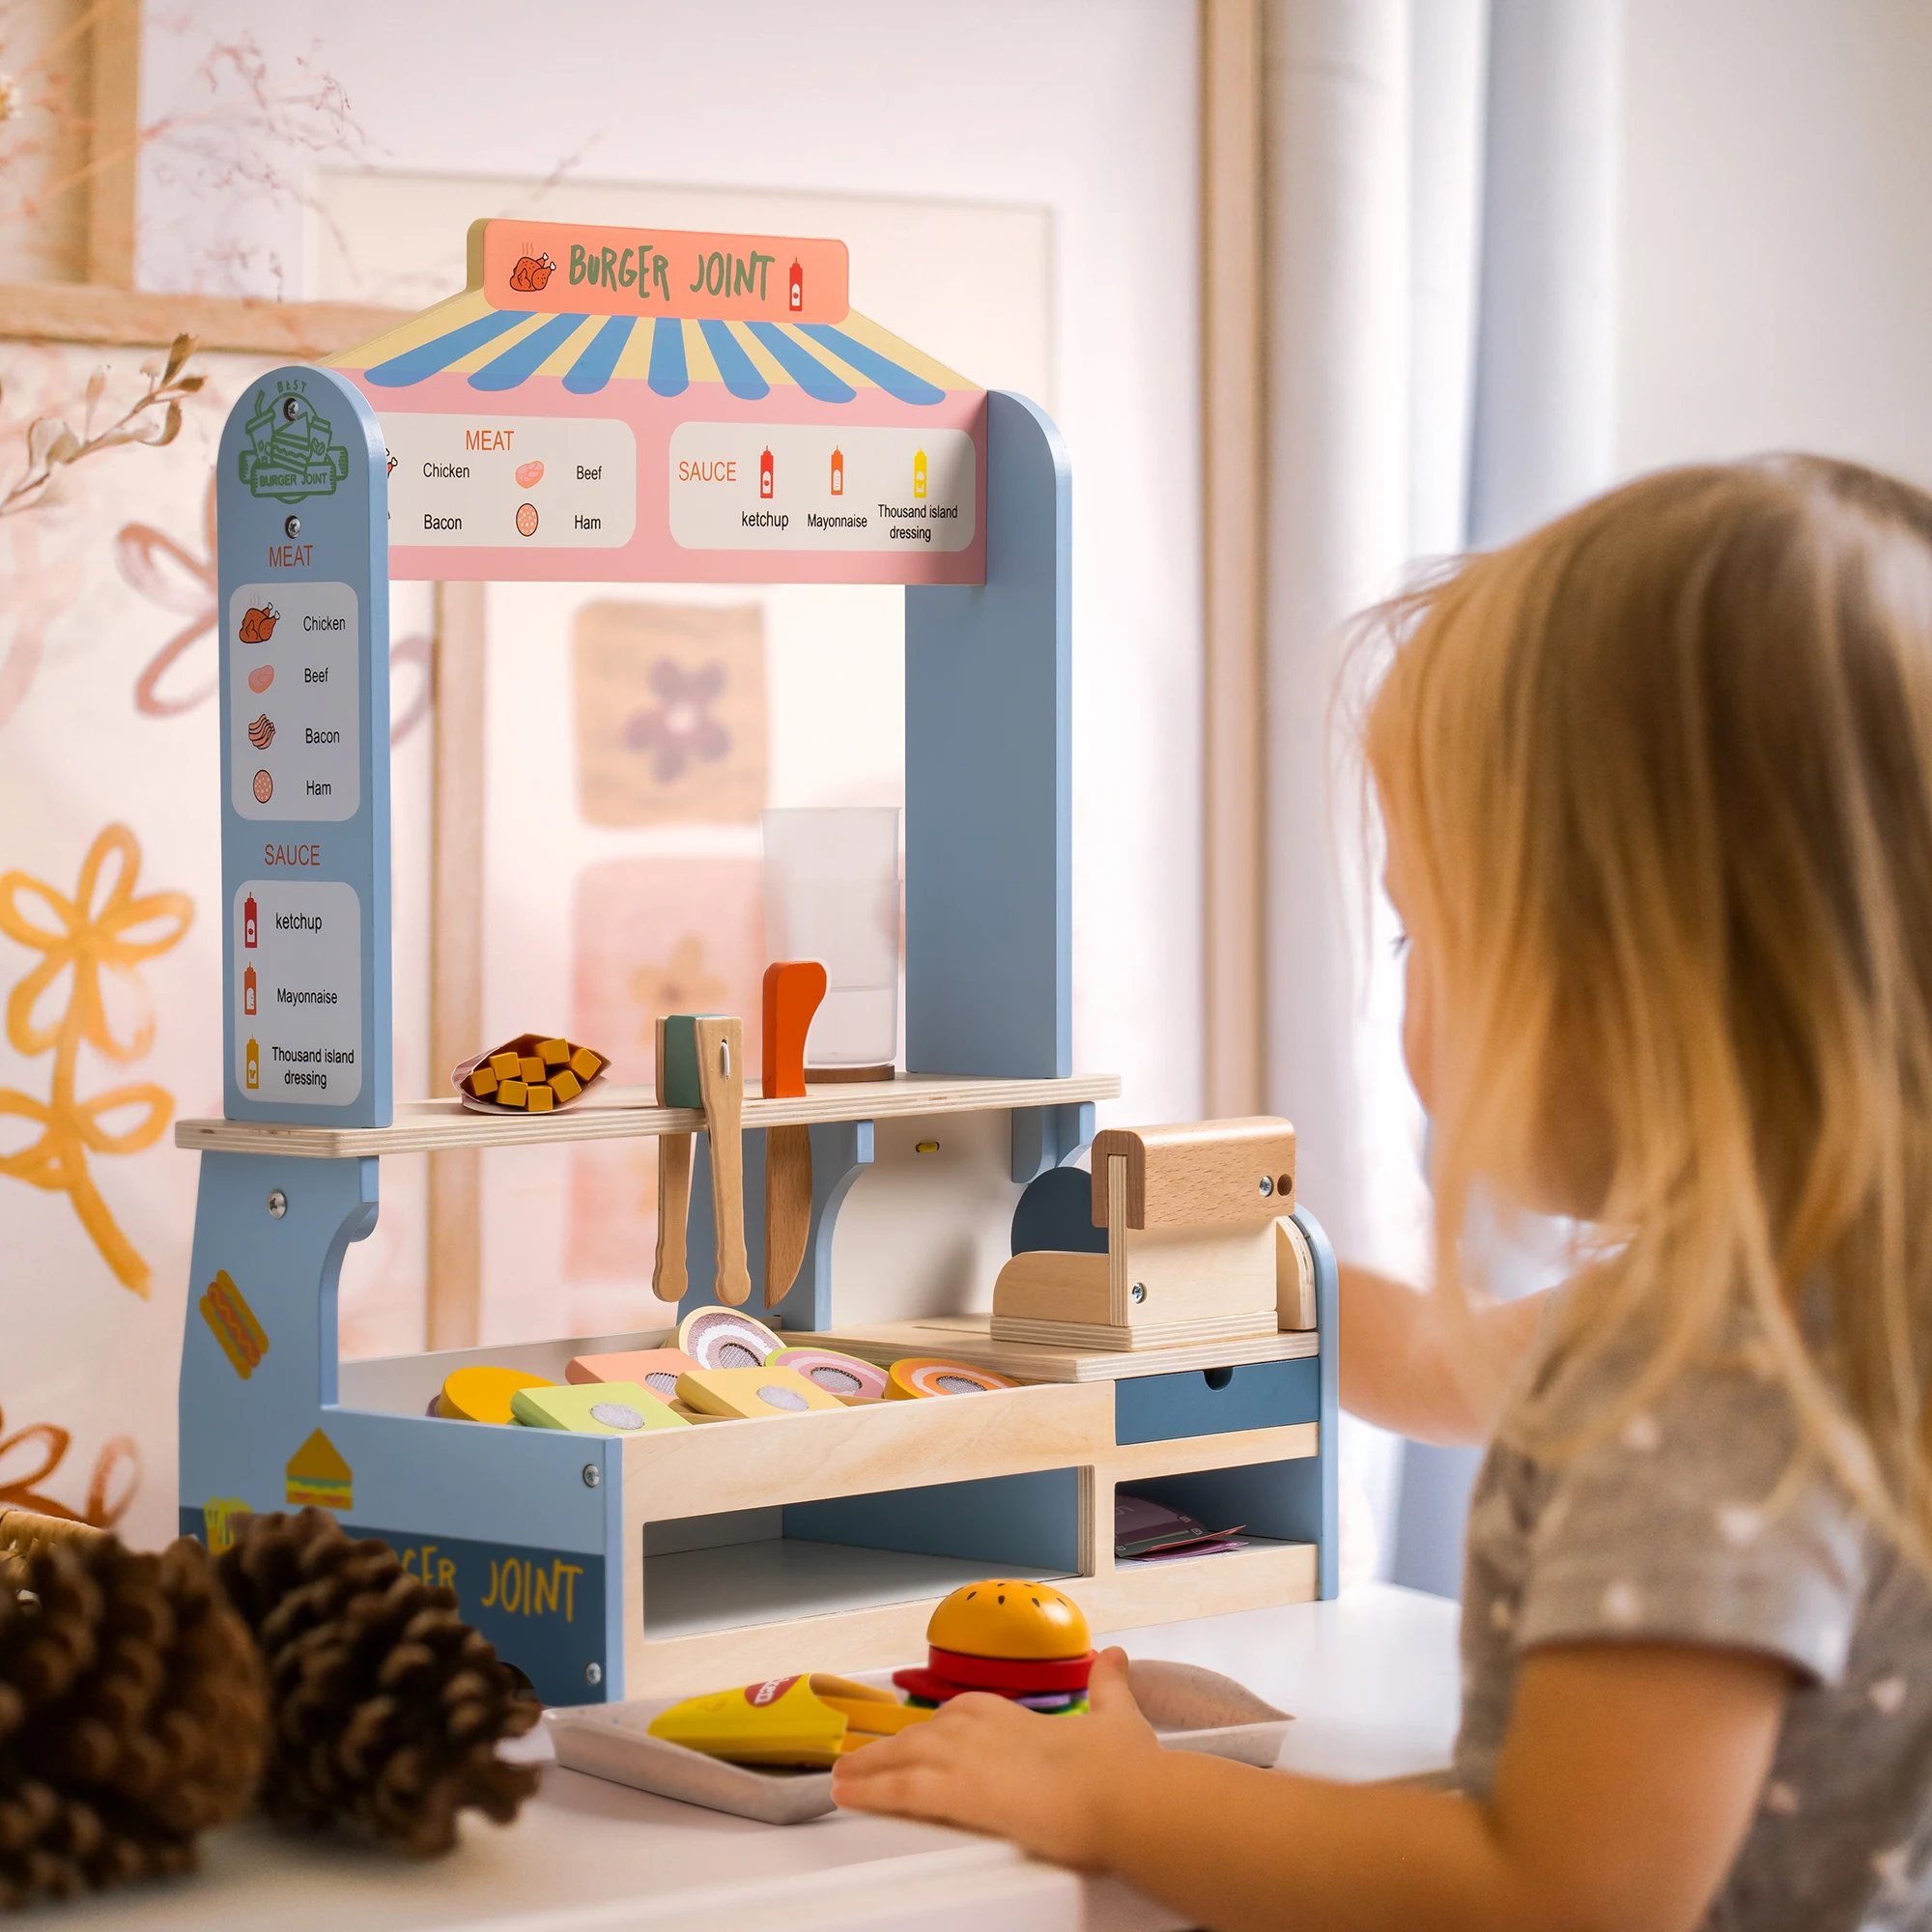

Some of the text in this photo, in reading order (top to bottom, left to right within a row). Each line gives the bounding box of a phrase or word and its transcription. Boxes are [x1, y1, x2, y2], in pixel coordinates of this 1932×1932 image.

[569, 243, 775, 301] BURGER JOINT
[466, 431, 514, 450] MEAT
[423, 463, 469, 479] Chicken
[577, 466, 602, 481] Beef
[678, 461, 737, 482] SAUCE
[259, 472, 327, 487] BURGER JOINT
[878, 504, 957, 519] Thousand island
[424, 514, 462, 530] Bacon
[574, 515, 601, 529] Ham
[741, 511, 789, 530] ketchup
[808, 514, 867, 530] Mayonnaise
[890, 526, 931, 542] dressing
[269, 545, 313, 567] MEAT
[303, 616, 346, 631] Chicken
[304, 668, 328, 683] Beef
[305, 728, 340, 744] Bacon
[306, 781, 331, 796] Ham
[264, 843, 321, 866] SAUCE
[275, 913, 323, 934] ketchup
[277, 988, 337, 1008] Mayonnaise
[271, 1047, 355, 1065] Thousand island
[284, 1070, 327, 1089] dressing
[481, 1558, 583, 1622] JOINT
